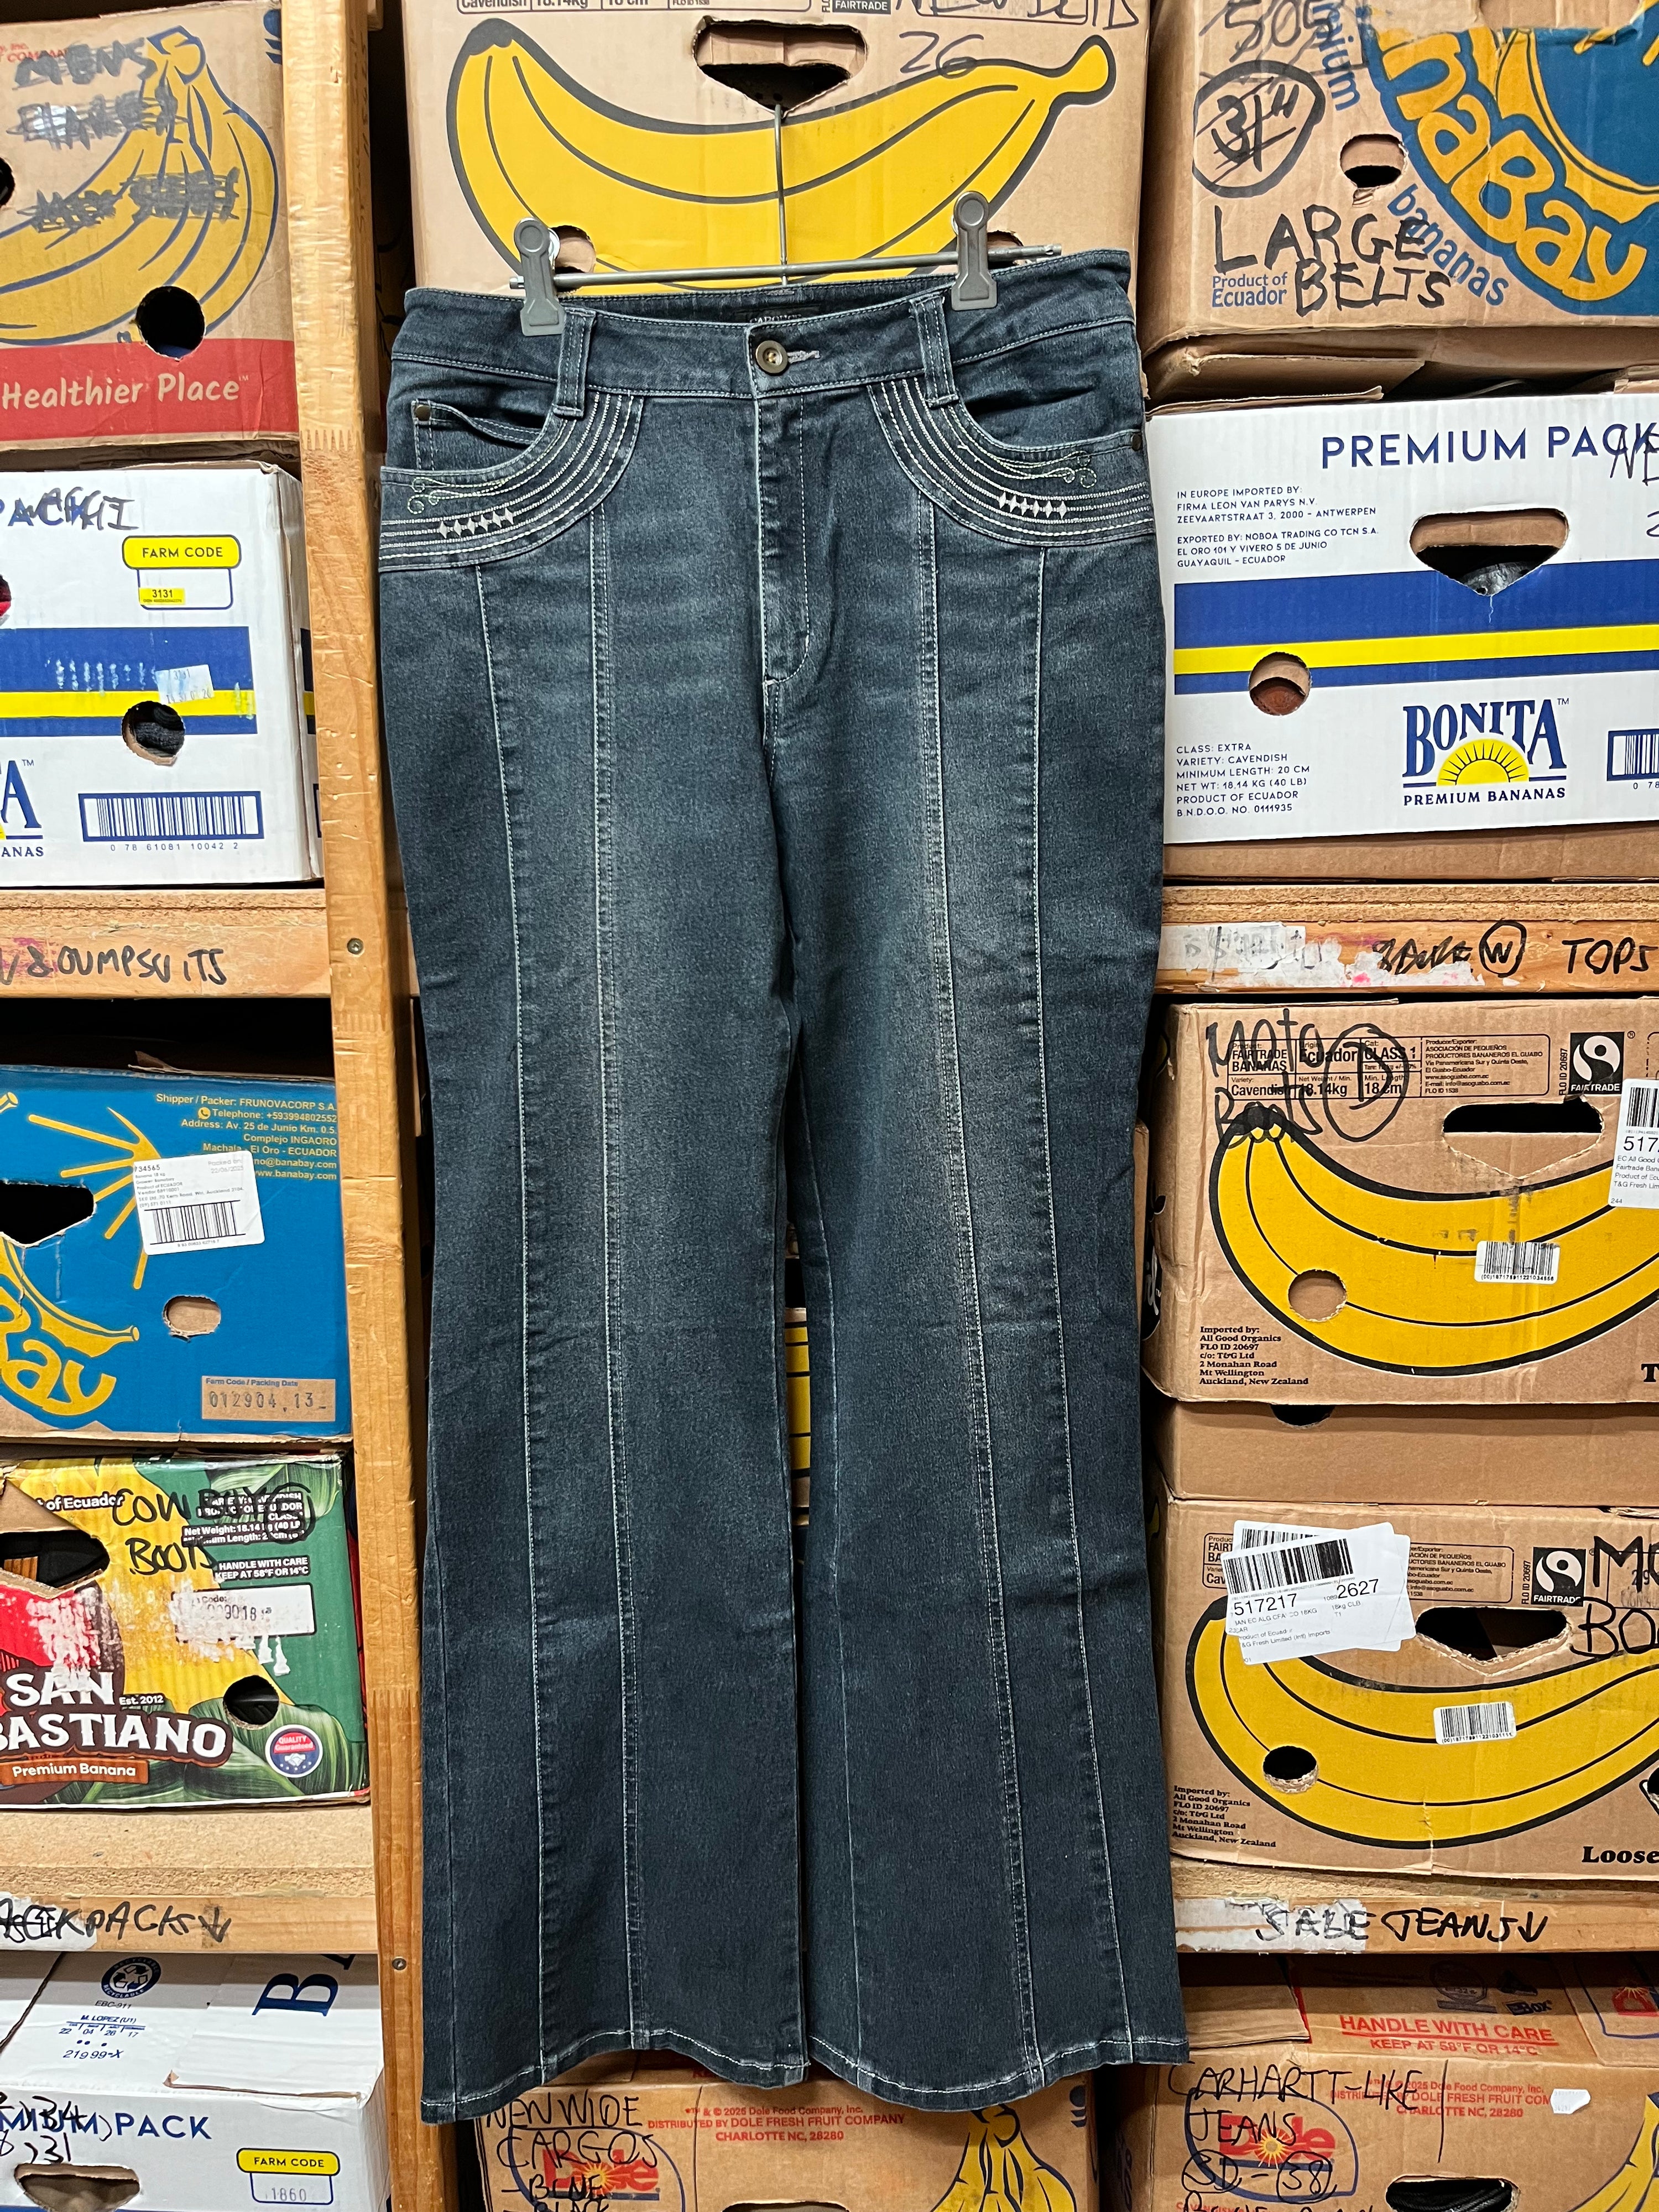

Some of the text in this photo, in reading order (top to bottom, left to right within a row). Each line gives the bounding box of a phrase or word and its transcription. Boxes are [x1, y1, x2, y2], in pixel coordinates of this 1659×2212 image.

[836, 1, 888, 11] FAIRTRADE
[900, 31, 984, 79] 26
[1214, 204, 1431, 275] LARGE
[1387, 183, 1509, 306] bananas
[1212, 272, 1288, 289] Product of
[1293, 257, 1452, 317] BELTS
[1212, 285, 1287, 307] Ecuador
[2, 372, 240, 410] Healthier Place
[1322, 427, 1526, 469] PREMIUM
[1191, 489, 1229, 498] EUROPE
[1233, 487, 1283, 497] IMPORTED
[1287, 486, 1302, 494] BY:
[1177, 503, 1207, 512] FIRMA
[1212, 502, 1237, 510] LEON
[1241, 500, 1260, 509] VAN
[1264, 499, 1295, 508] PARYS
[1177, 507, 1376, 524] ZEEVAARTSTRAAT 3, 2000 ANTWERPEN
[1178, 535, 1224, 544] EXPORTED
[1228, 534, 1243, 542] BY:
[1246, 532, 1277, 541] NOBOA
[1281, 530, 1321, 539] TRADING
[143, 547, 223, 558] FARM CODE
[1240, 544, 1273, 552] VIVERO
[1299, 541, 1327, 550] JUNIO
[1178, 555, 1285, 568] GUAYAQUIL ECUADOR
[152, 589, 173, 598] 3131
[1402, 699, 1567, 778] BONITA
[1177, 743, 1251, 753] CLASS: EXTRA
[1177, 754, 1287, 766] VARIETY: CAVENDISH
[1177, 770, 1225, 779] MINIMUM
[1230, 767, 1273, 776] LENGTH:
[1177, 783, 1197, 792] NET
[1201, 782, 1219, 790] WT:
[1223, 781, 1248, 789] 18.14
[1177, 794, 1226, 804] PRODUCT
[1249, 791, 1298, 800] ECUADOR
[1404, 787, 1565, 806] PREMIUM BANANAS
[1254, 804, 1292, 813] 0111935
[1232, 1050, 1287, 1060] FAIRTRADE
[1232, 1061, 1287, 1072] BANANAS
[156, 1093, 315, 1110] Shipper Packer: FRUNOVACORP
[213, 1109, 263, 1119] Telephone:
[243, 1134, 336, 1145] Complejo INGAORO
[251, 1379, 280, 1387] Packing
[46, 1494, 124, 1511] of Ecuador
[202, 1524, 260, 1535] Weight: 18.14
[219, 1557, 308, 1571] HANDLE WITH CARE
[1335, 1578, 1379, 1599] 2627
[1234, 1592, 1297, 1616] 517217
[6, 1671, 115, 1707] SAN
[119, 1694, 164, 1706] Est. 2012
[278, 1735, 307, 1745] QUALITY
[12, 1762, 136, 1777] Premium Banana
[95, 2000, 132, 2010] EBC-911
[1340, 2015, 1554, 2041] HANDLE WITH CARE
[116, 2112, 212, 2140] PACK
[731, 2114, 905, 2127] DOLE FRESH FRUIT COMPANY
[1188, 2107, 1297, 2146] JEANS
[716, 2131, 844, 2142] CHARLOTTE NC, 28280
[497, 2129, 658, 2170] CARGOS
[254, 2156, 325, 2168] FARM CODE
[271, 2187, 307, 2202] 1860
